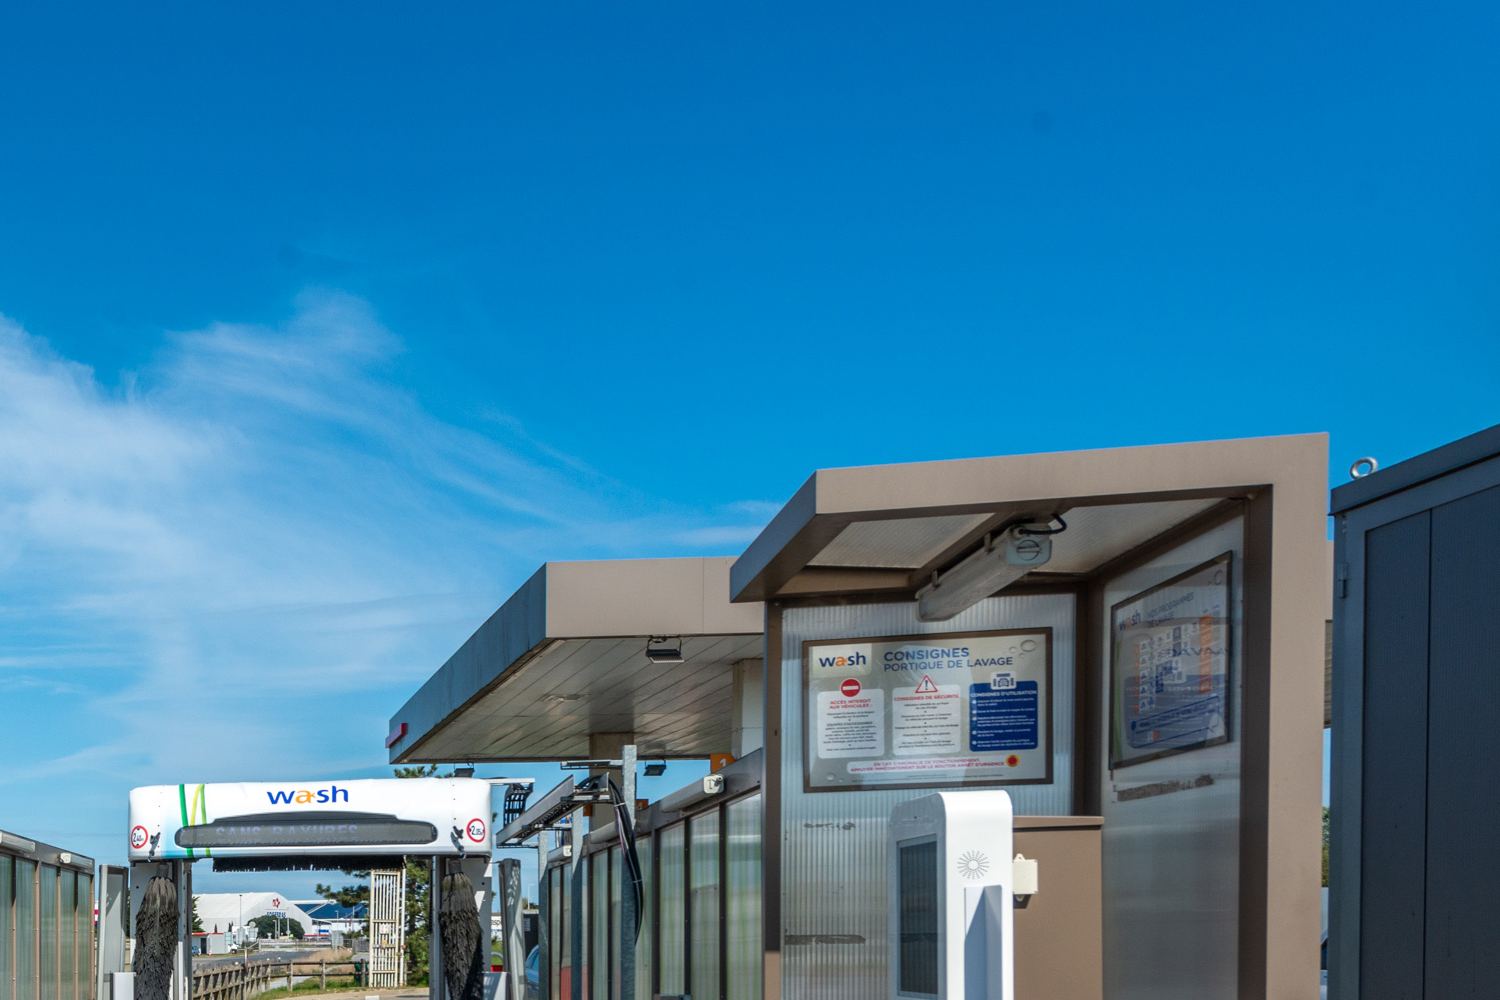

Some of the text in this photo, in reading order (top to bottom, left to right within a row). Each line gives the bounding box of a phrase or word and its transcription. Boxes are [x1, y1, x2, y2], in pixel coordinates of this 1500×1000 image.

[819, 652, 866, 667] wash
[884, 648, 969, 661] CONSIGNES
[884, 657, 1013, 672] PORTIQUE DE LAVAGE
[267, 786, 348, 804] wash
